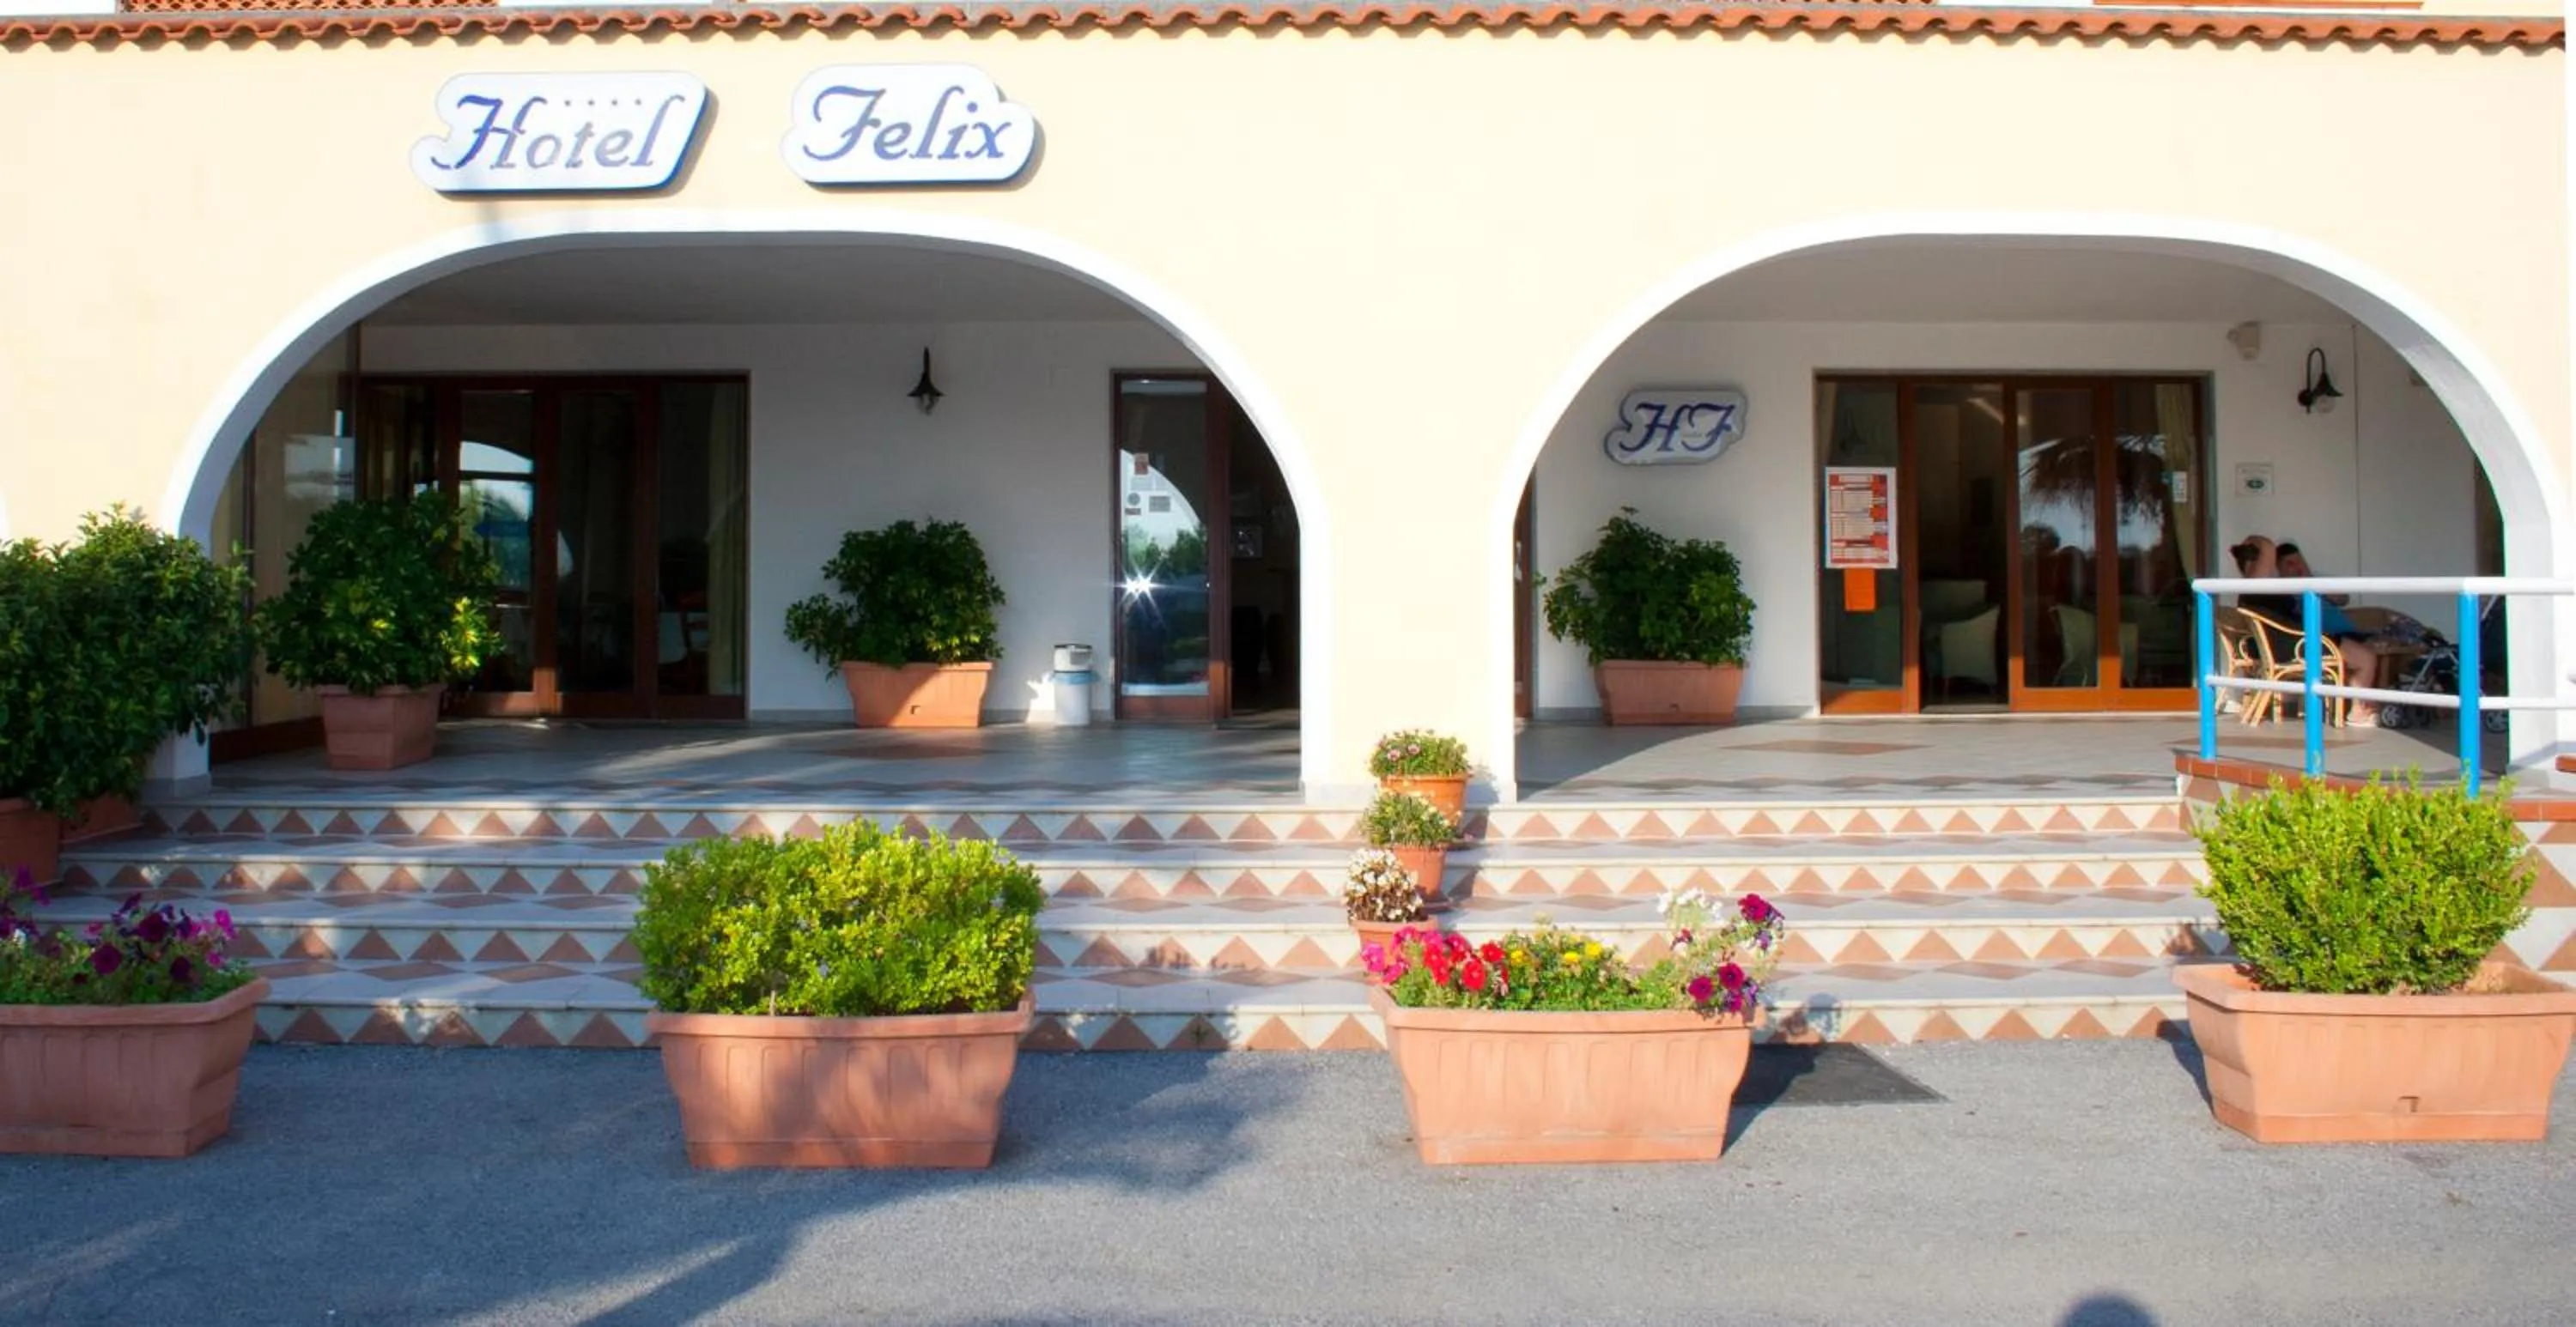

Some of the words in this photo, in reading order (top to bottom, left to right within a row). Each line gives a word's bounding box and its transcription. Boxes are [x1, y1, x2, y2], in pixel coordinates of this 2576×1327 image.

[430, 94, 685, 170] Hotel
[803, 85, 1012, 161] Felix
[1619, 403, 1735, 452] HF
